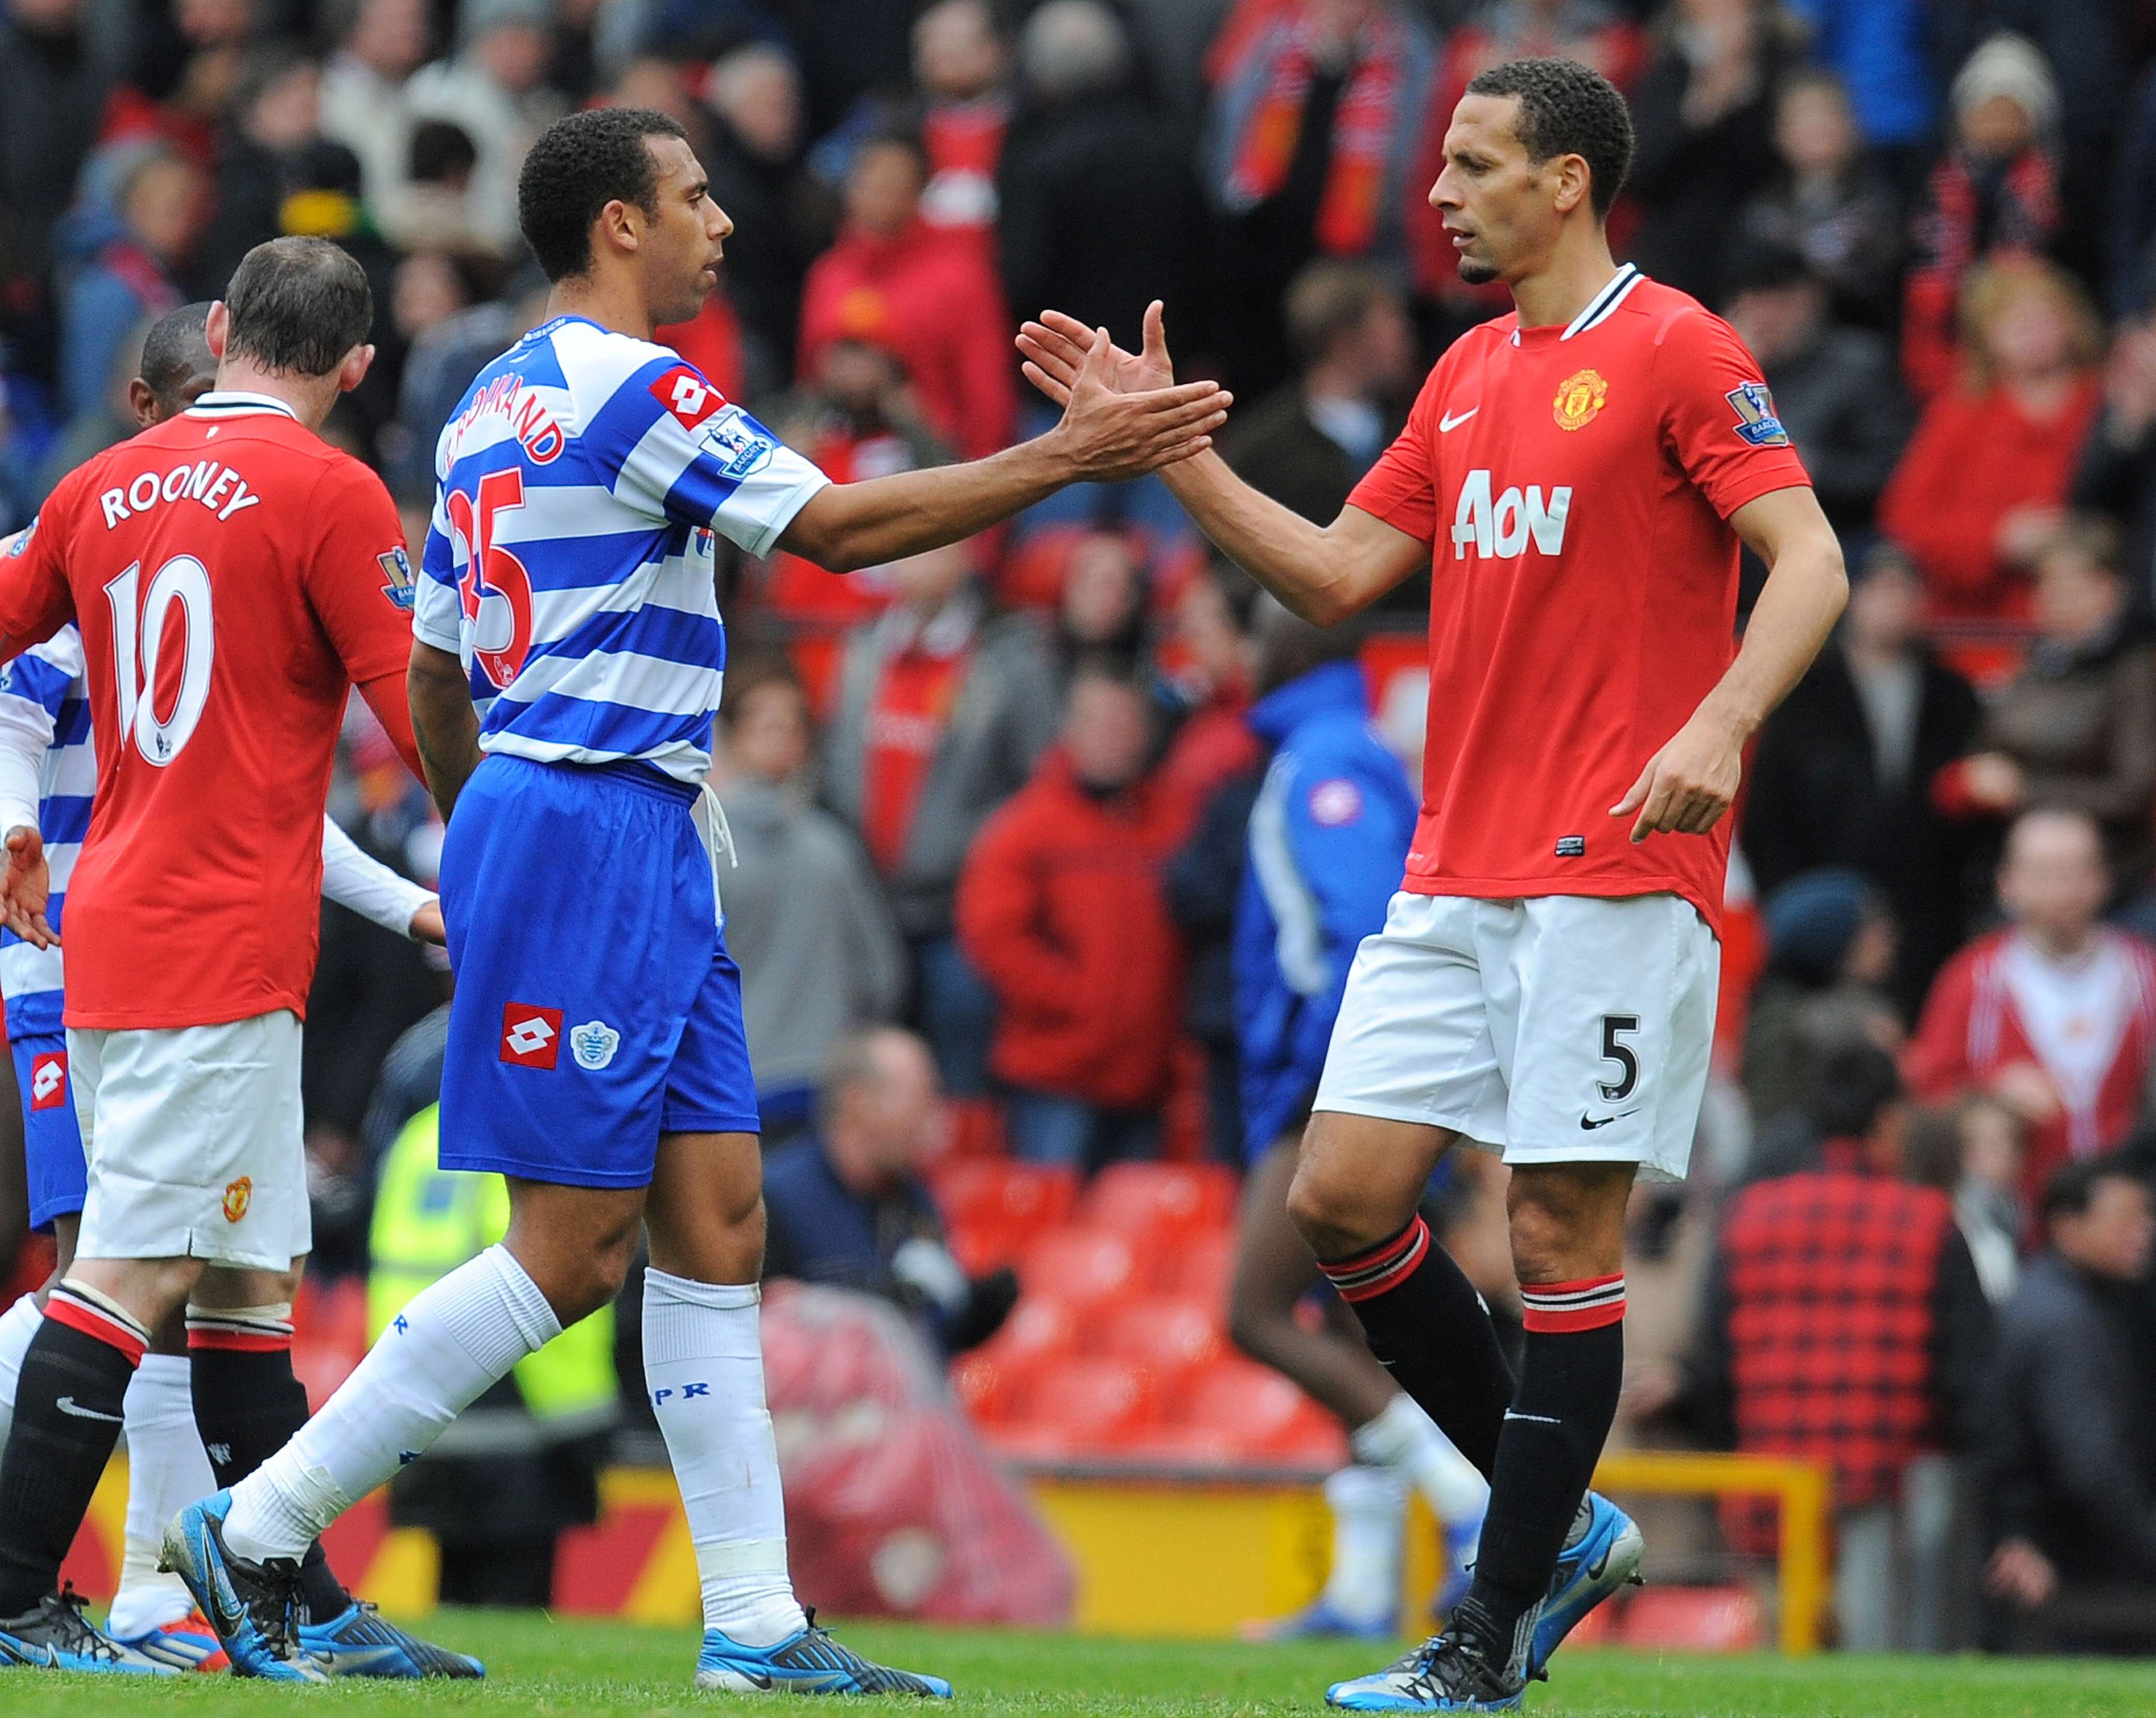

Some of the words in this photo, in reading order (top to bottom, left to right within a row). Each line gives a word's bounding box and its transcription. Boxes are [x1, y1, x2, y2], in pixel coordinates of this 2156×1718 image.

[445, 372, 565, 472] ERDINAND
[100, 460, 260, 531] ROONEY
[446, 465, 534, 691] 35
[102, 553, 215, 768] 10
[1595, 1013, 1641, 1104] 5
